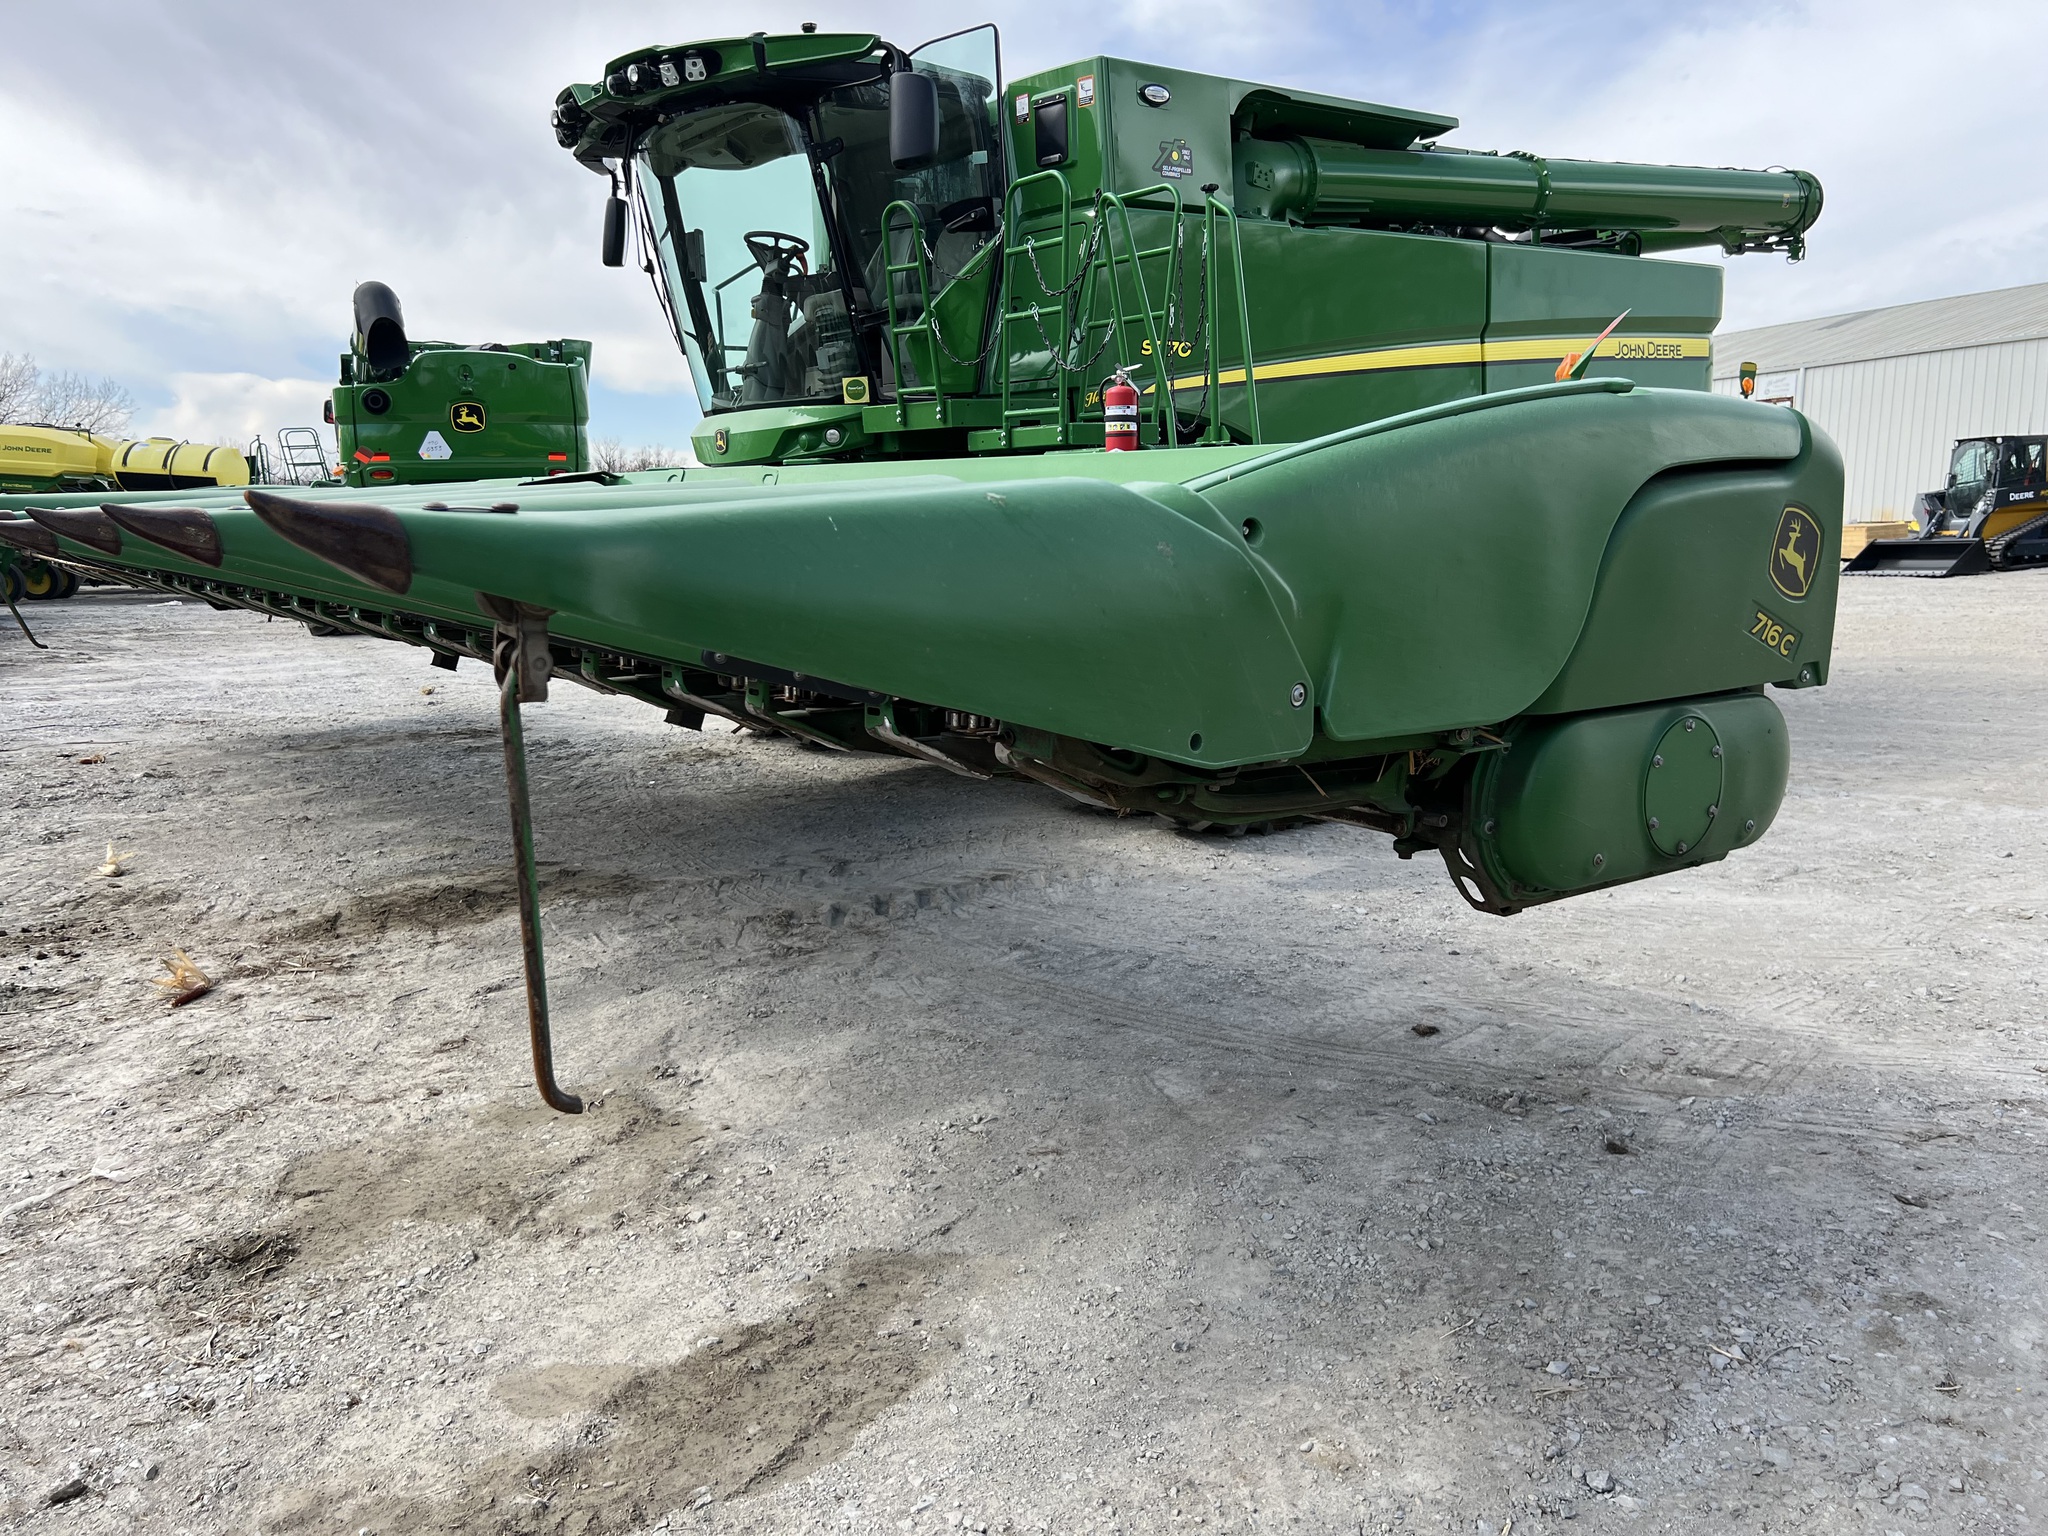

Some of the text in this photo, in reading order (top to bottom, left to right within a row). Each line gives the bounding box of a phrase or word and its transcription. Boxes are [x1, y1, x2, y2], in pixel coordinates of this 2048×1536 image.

[1141, 339, 1192, 358] S70
[1615, 341, 1682, 357] JOHN DEERE
[25, 446, 52, 454] DEERE
[2009, 491, 2035, 501] DEERE
[1751, 611, 1796, 656] 716C
